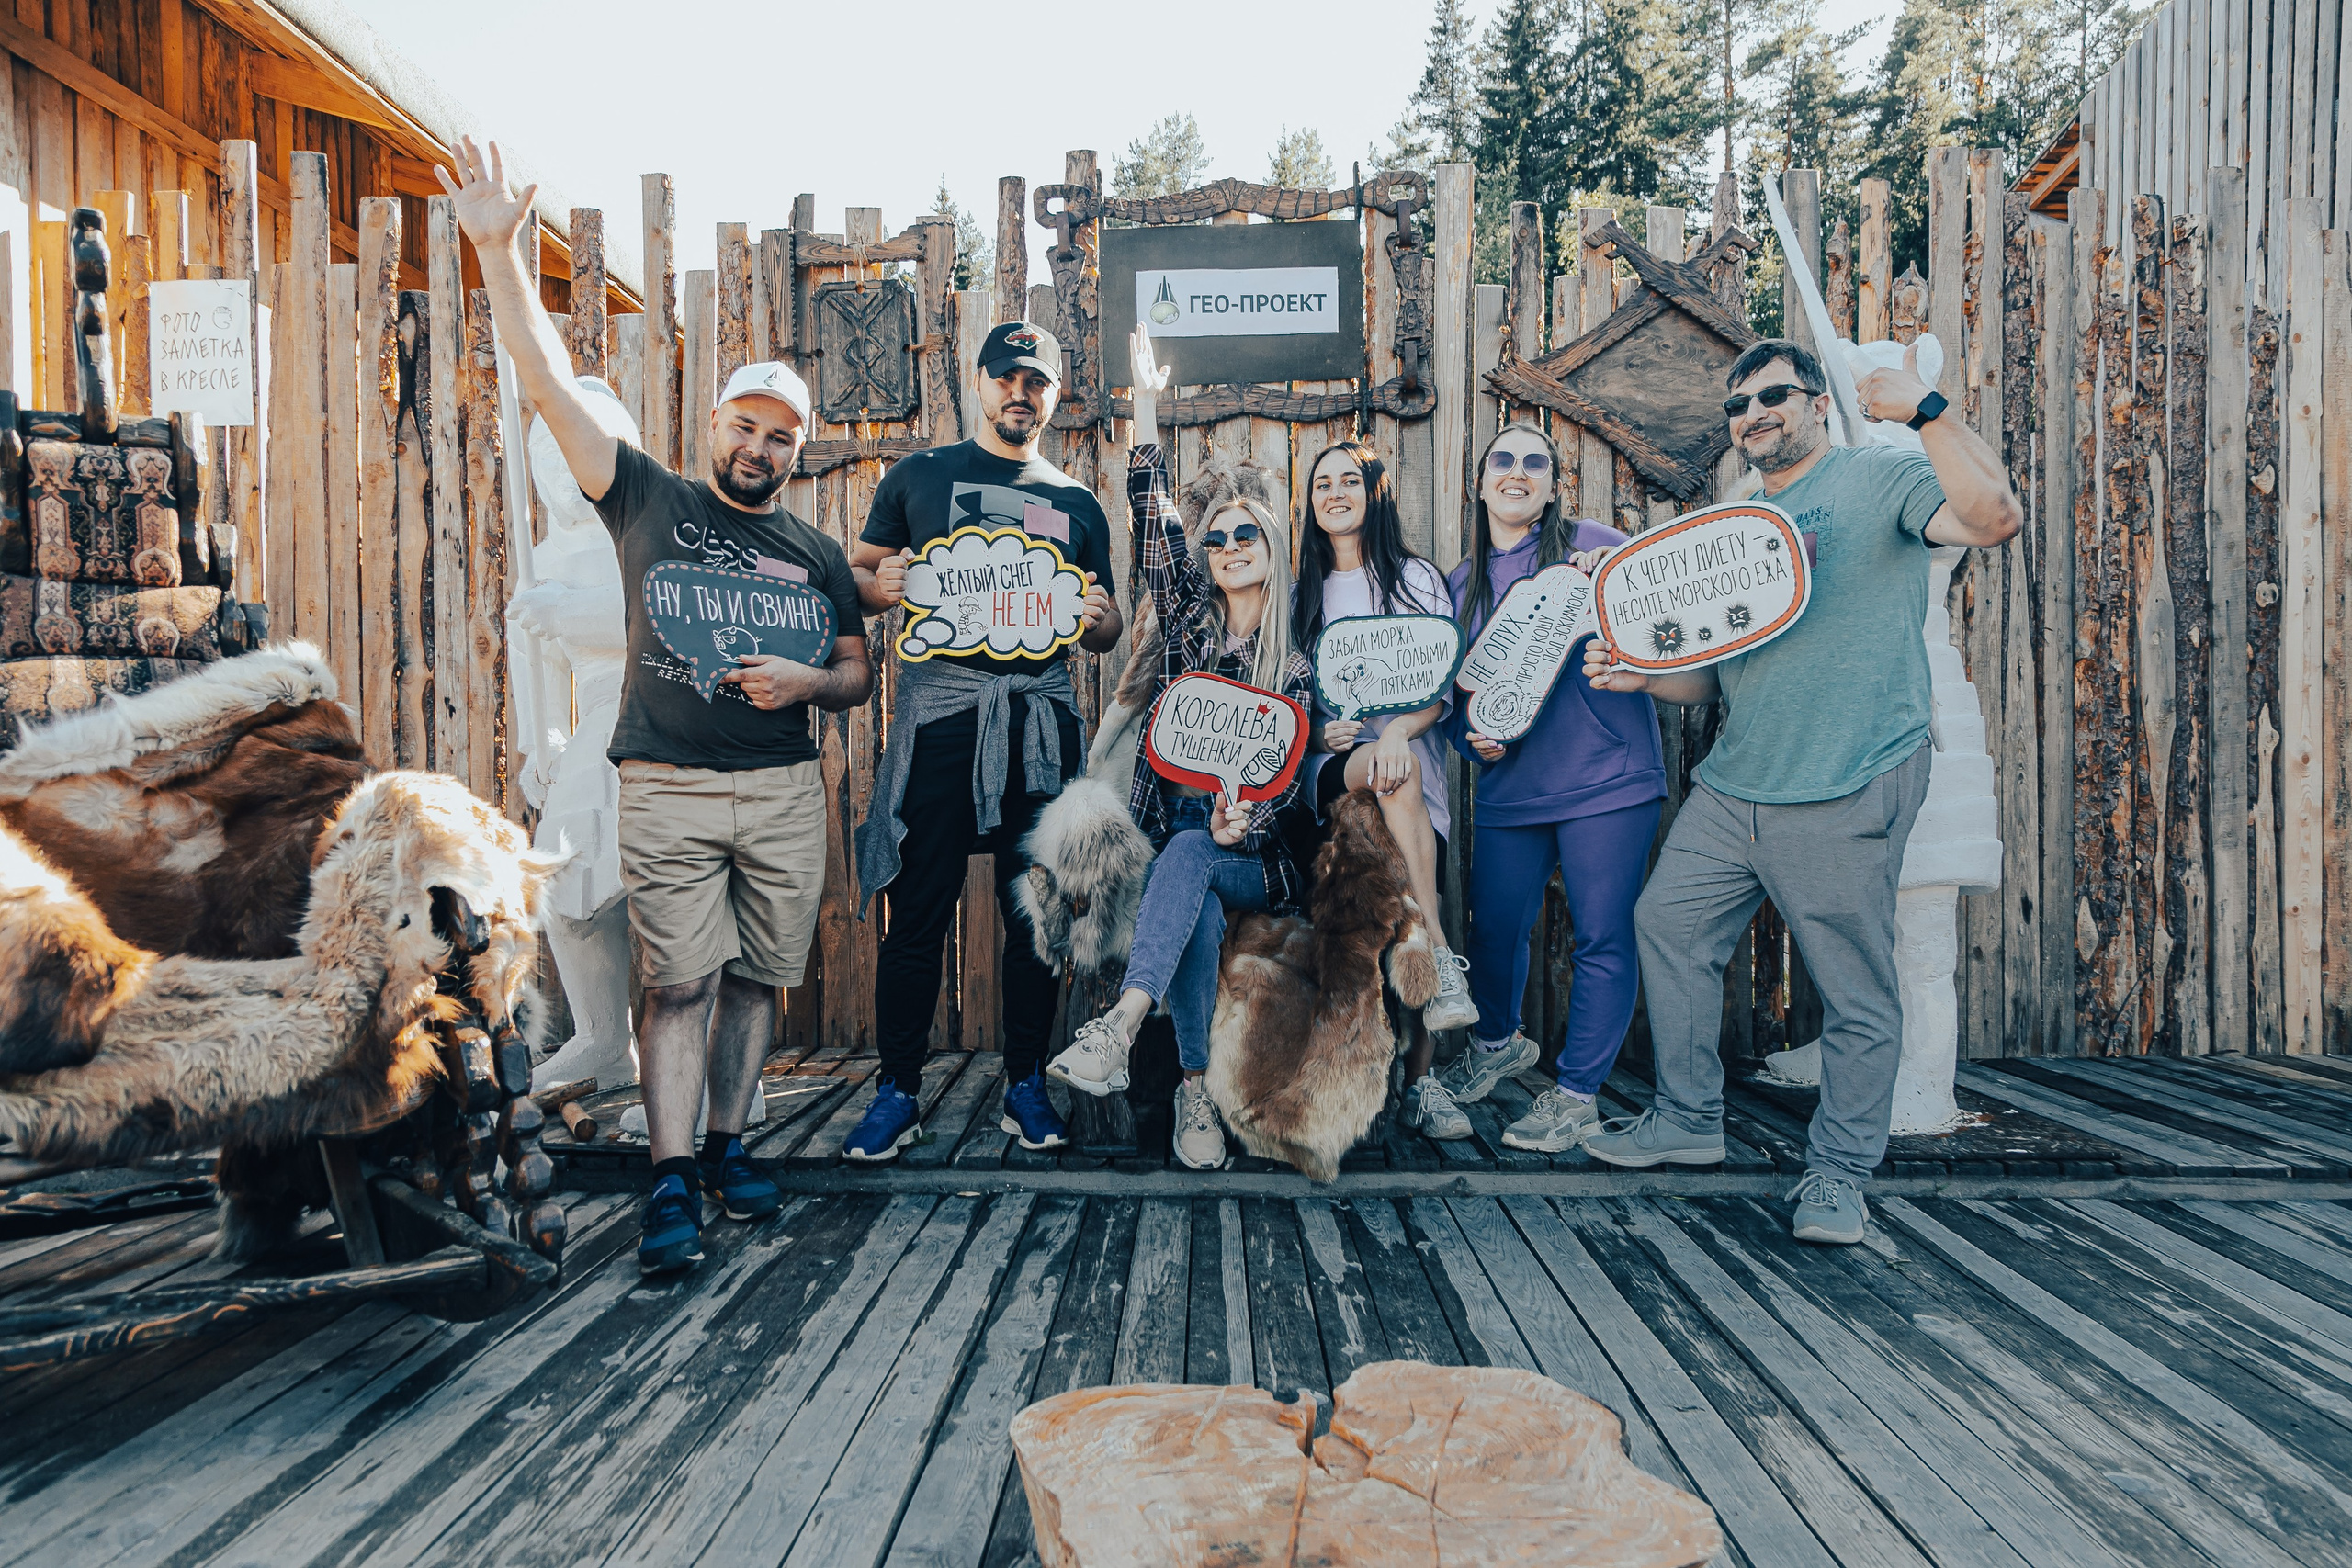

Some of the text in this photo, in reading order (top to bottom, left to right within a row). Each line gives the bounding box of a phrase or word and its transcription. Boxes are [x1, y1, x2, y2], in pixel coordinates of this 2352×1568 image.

[1190, 293, 1327, 314] ГЕО-ПРОЕКТ
[160, 311, 201, 333] ФОТО
[161, 337, 245, 360] ЗАМЕТКА
[161, 367, 240, 392] В КРЕСЛЕ
[936, 560, 1034, 598] ЖЁЛТЫЙ СНЕГ
[1623, 564, 1639, 592] К
[1640, 548, 1688, 588] ЧЕРТУ
[1696, 530, 1746, 573] ДИЕТУ
[655, 580, 691, 625] НУ,
[693, 585, 724, 623] ТЫ
[727, 589, 746, 625] И
[1612, 556, 1788, 626] НЕСИТЕ МОРСКОГО ЕЖА
[992, 592, 1053, 627] НЕ ЕМ
[1542, 586, 1590, 663] ПОД ЭСКИМОСА
[1328, 624, 1415, 660] ЗАБИЛ МОРЖА
[1396, 640, 1449, 670] ГОЛЫМИ
[1464, 658, 1498, 685] НЕ
[1516, 644, 1544, 684] ПРОСТО
[1380, 669, 1434, 697] ПЯТКАМИ
[1170, 694, 1278, 744] КОРОЛЕВА
[1170, 731, 1243, 767] ТУШЕНКИ
